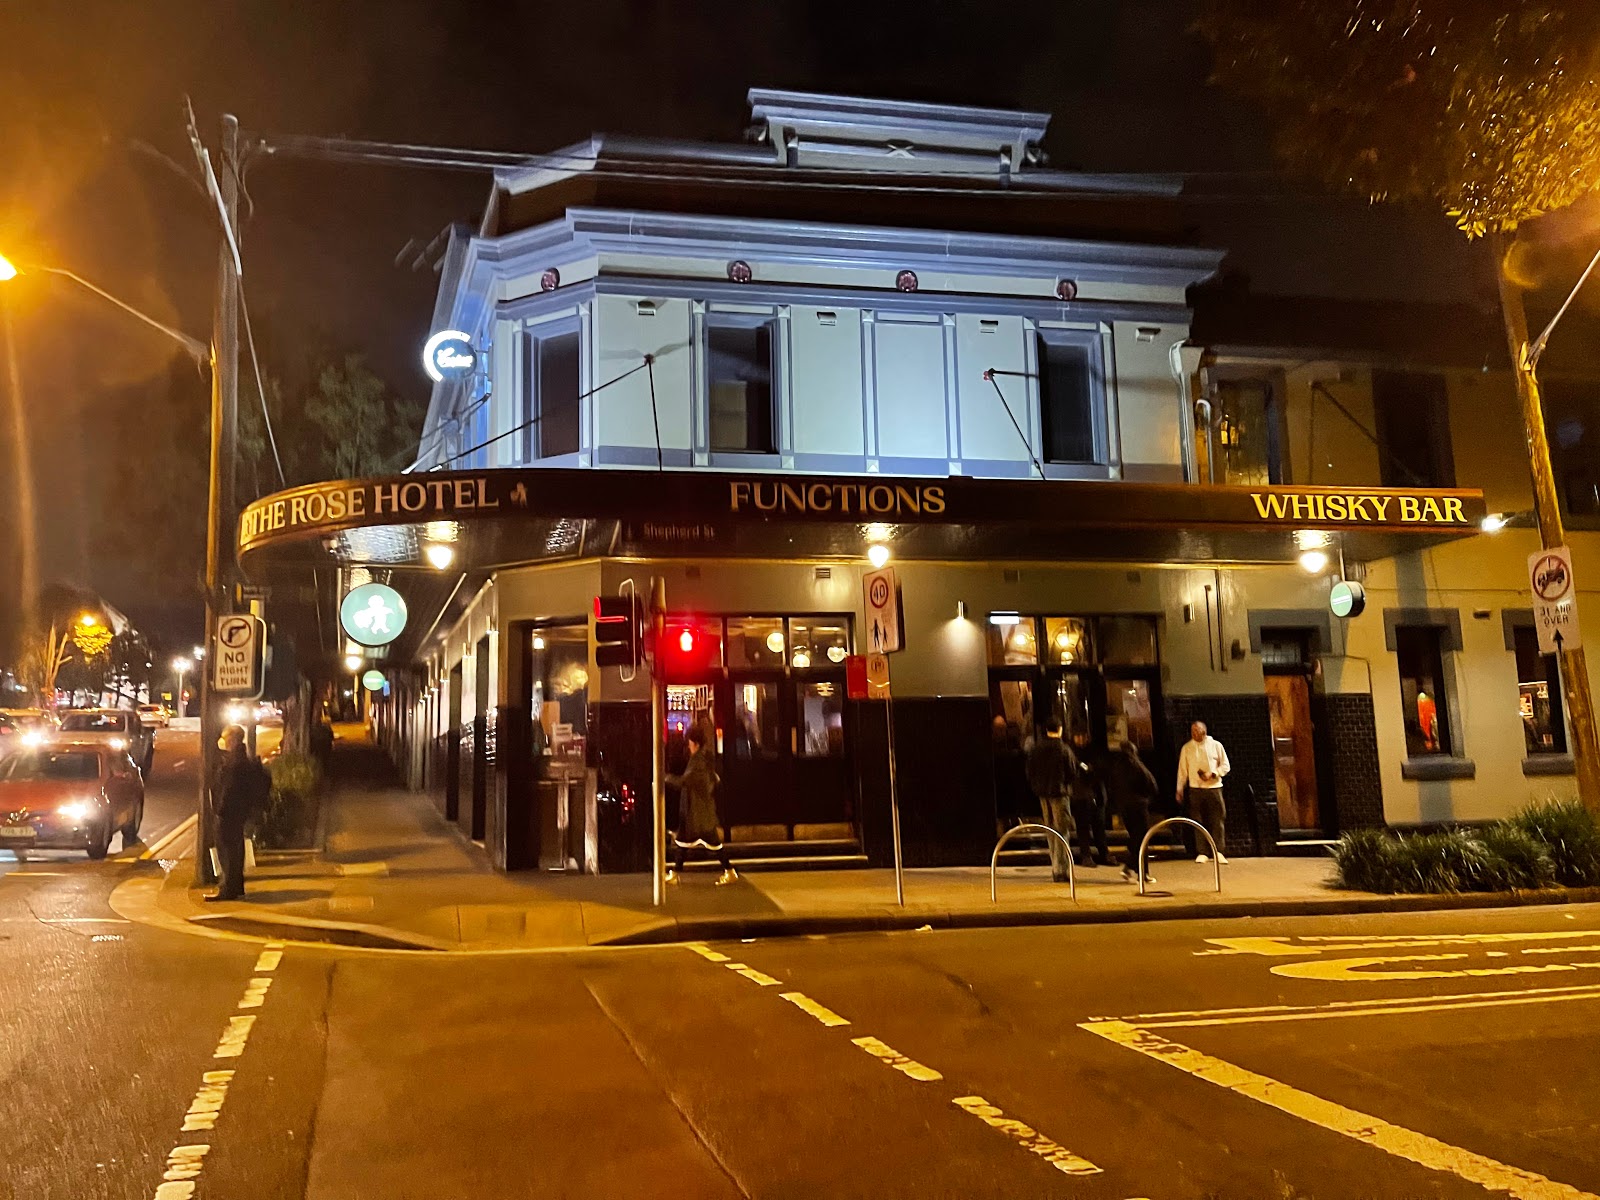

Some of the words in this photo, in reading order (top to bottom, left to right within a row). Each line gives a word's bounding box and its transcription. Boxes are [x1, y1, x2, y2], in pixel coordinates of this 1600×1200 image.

[729, 481, 946, 513] FUNCTIONS
[250, 501, 286, 533] THE
[291, 488, 365, 525] ROSE
[374, 478, 499, 514] HOTEL
[1250, 493, 1392, 521] WHISKY
[1398, 496, 1468, 522] BAR
[873, 584, 886, 602] 40
[1554, 604, 1571, 615] AND
[1544, 615, 1569, 628] OVER
[225, 651, 245, 663] NO
[219, 665, 249, 676] RIGHT
[220, 677, 248, 687] TURN
